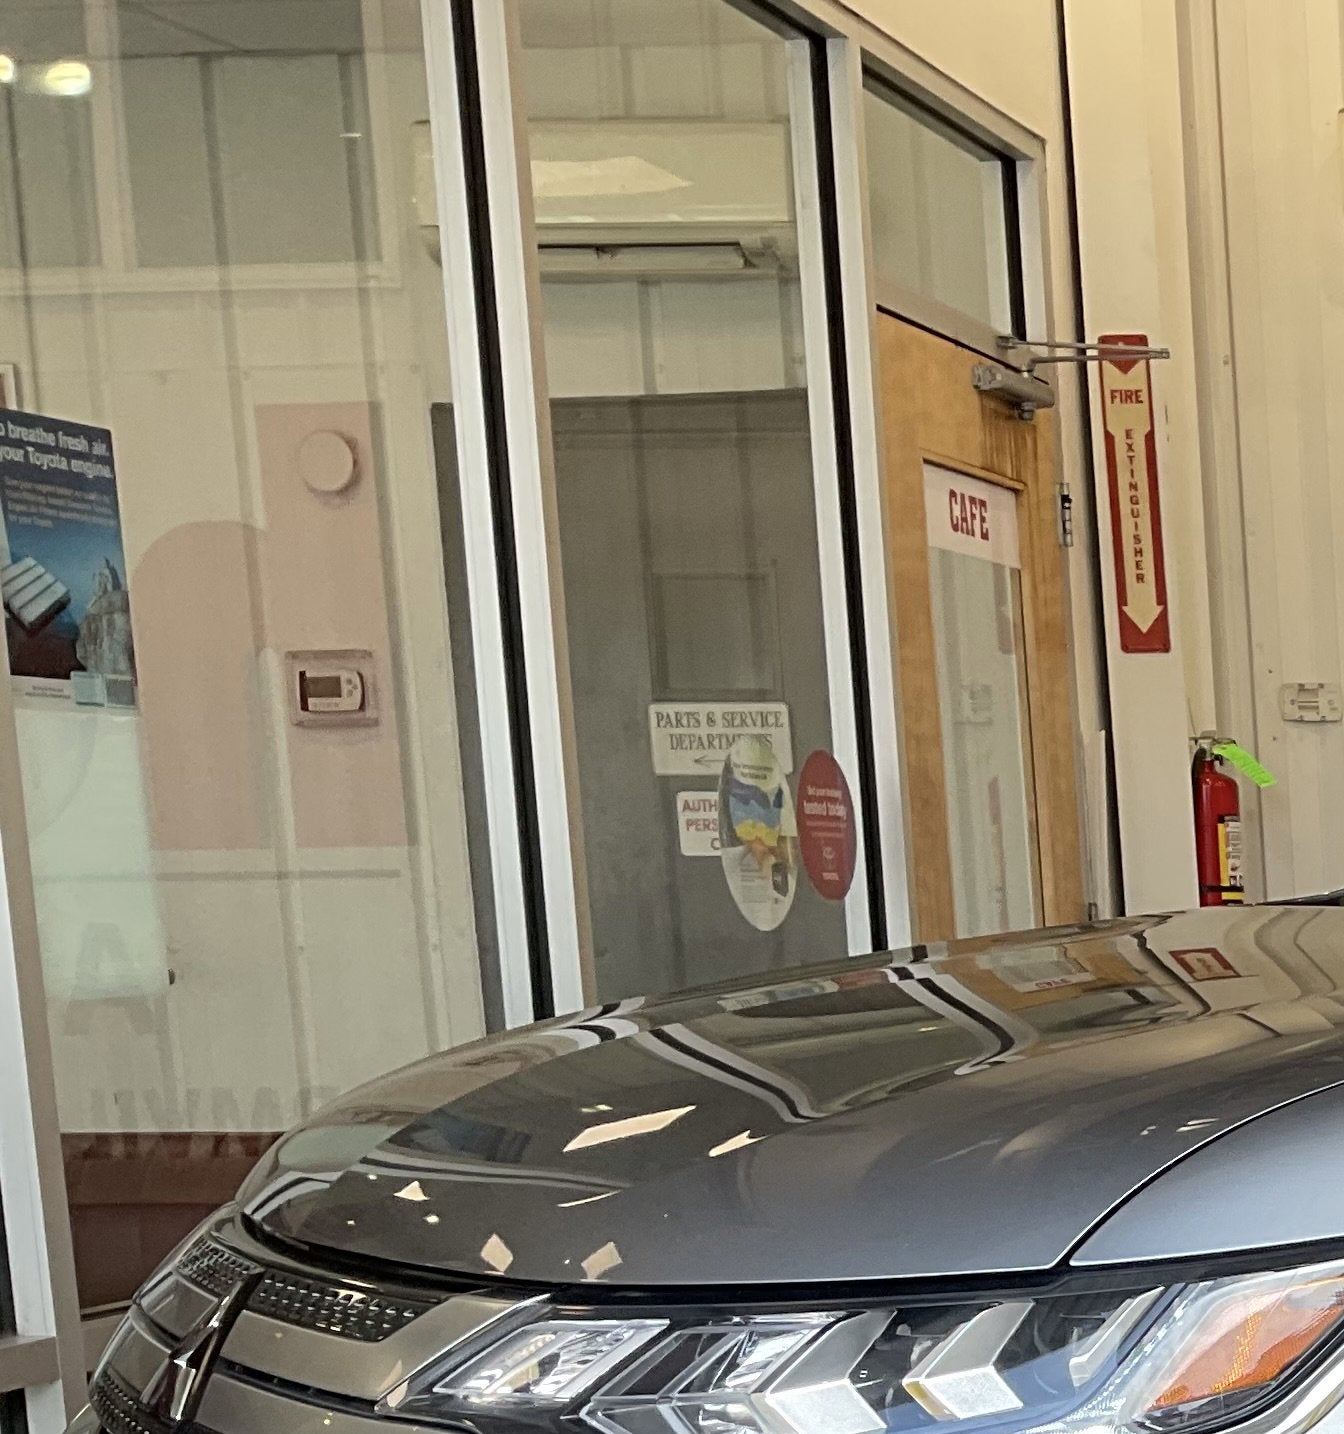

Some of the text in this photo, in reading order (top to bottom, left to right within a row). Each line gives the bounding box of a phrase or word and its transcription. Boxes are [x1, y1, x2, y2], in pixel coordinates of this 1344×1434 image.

[1110, 389, 1144, 404] FIRE
[7, 420, 56, 446] breathe
[57, 431, 89, 452] fresh
[25, 446, 69, 470] Toyota
[949, 488, 989, 541] CAFE
[1125, 429, 1145, 584] EXTINGUISHER
[655, 711, 783, 728] PARTS & SERVICE
